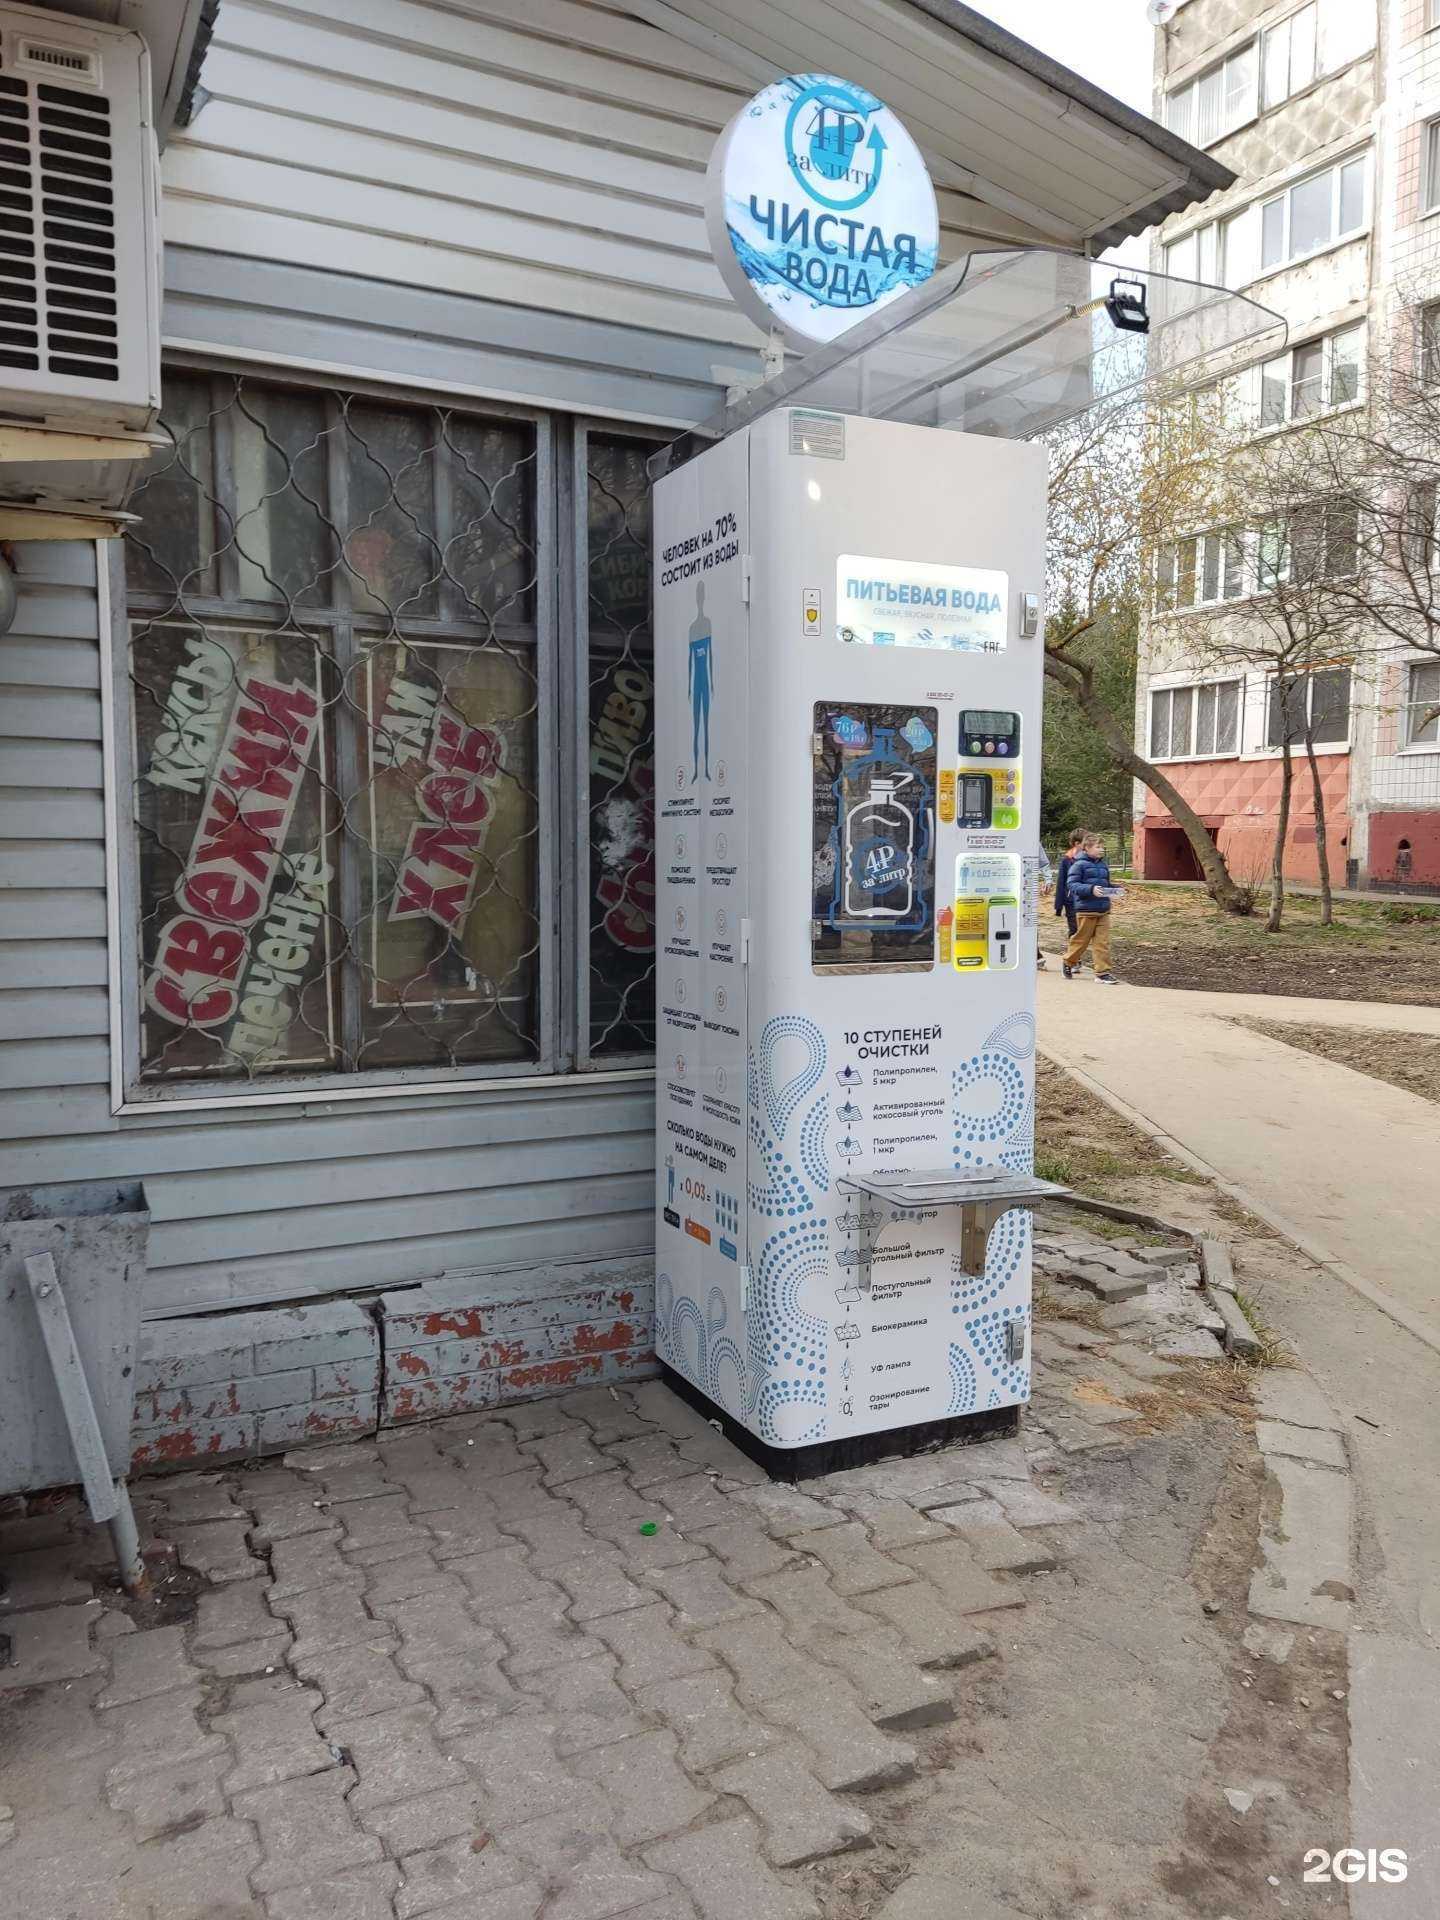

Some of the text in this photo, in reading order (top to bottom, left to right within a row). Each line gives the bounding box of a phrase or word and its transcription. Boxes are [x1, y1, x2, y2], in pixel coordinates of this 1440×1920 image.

[788, 153, 812, 174] за
[749, 194, 917, 275] ЧИСТАЯ
[785, 251, 873, 304] ВОДА
[662, 512, 737, 564] ЧЕЛОВЕК НА 70%
[661, 558, 702, 587] СОСТОИТ
[703, 552, 714, 570] ИЗ
[714, 539, 739, 565] ВОДЫ
[846, 578, 1002, 615] ПИТЬЕВАЯ ВОДА
[843, 1024, 942, 1045] 10 СТУПЕНЕЙ
[857, 1043, 929, 1060] ОЧИСТКИ
[873, 1066, 938, 1079] Полипропилен,
[879, 1077, 897, 1086] мкр
[873, 1098, 946, 1112] Активированный
[873, 1107, 944, 1120] кокосовый уголь
[666, 1119, 736, 1158] СКОЛЬКО ВОДЫ НУЖНО
[873, 1133, 938, 1147] Полипропилен,
[675, 1141, 727, 1174] НА САМОМ ДЕЛЕ?
[878, 1145, 895, 1155] мкр
[685, 1176, 706, 1202] 0,03
[872, 1247, 945, 1265] угольный фильтр
[873, 1242, 911, 1255] Большой
[871, 1277, 932, 1294] Постугольный
[871, 1291, 903, 1303] фильтр
[871, 1317, 928, 1333] Биокерамика
[871, 1360, 912, 1374] УФ лампа
[869, 1385, 931, 1403] Озонирование
[869, 1401, 890, 1412] тары
